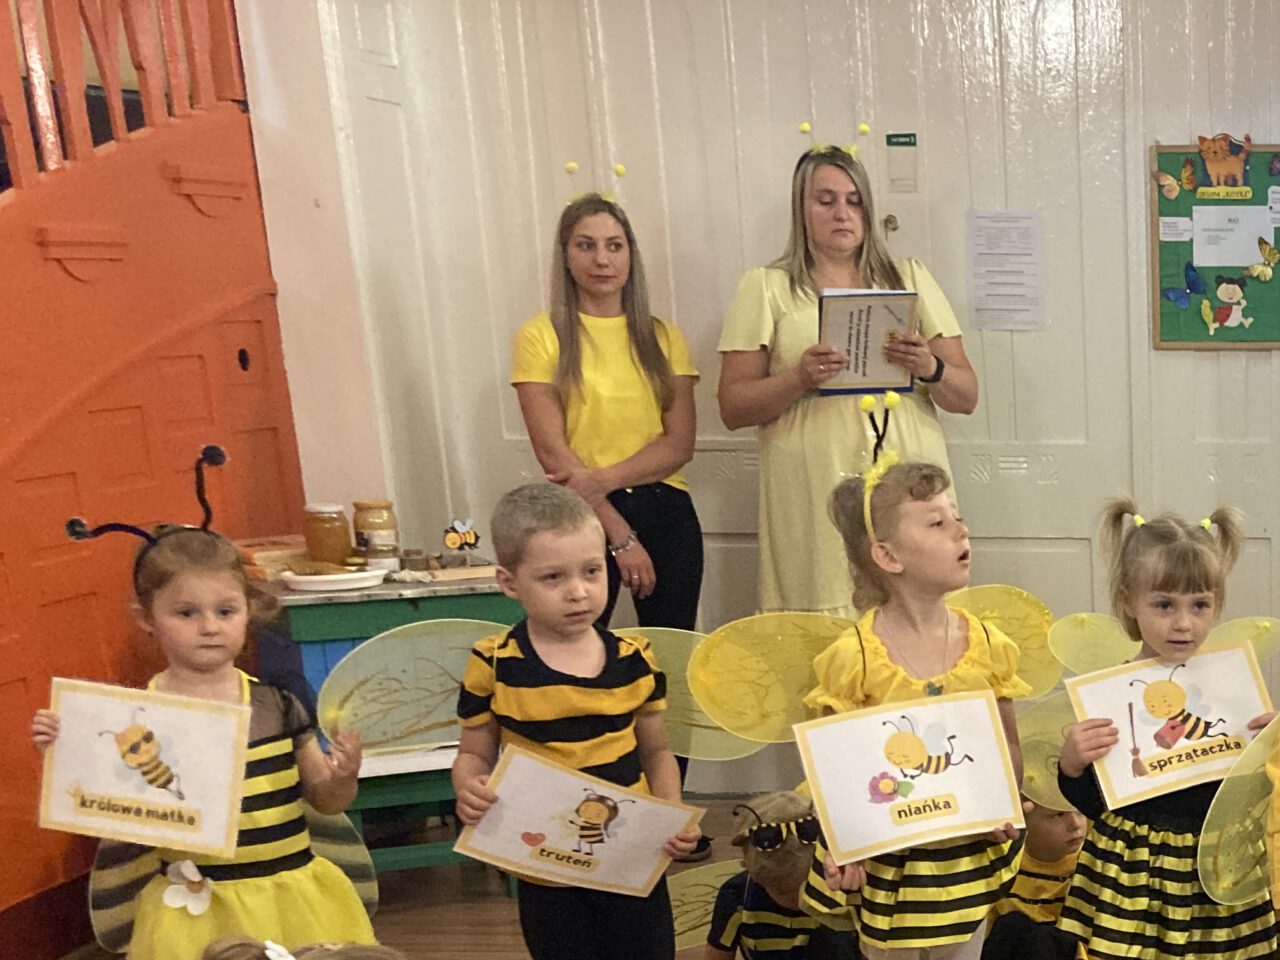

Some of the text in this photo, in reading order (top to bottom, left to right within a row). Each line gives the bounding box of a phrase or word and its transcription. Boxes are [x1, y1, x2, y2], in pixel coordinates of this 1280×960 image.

[1148, 739, 1242, 772] sprzątaczka
[79, 794, 196, 826] królowa matka
[897, 798, 952, 819] niańka
[538, 847, 592, 868] truteń
